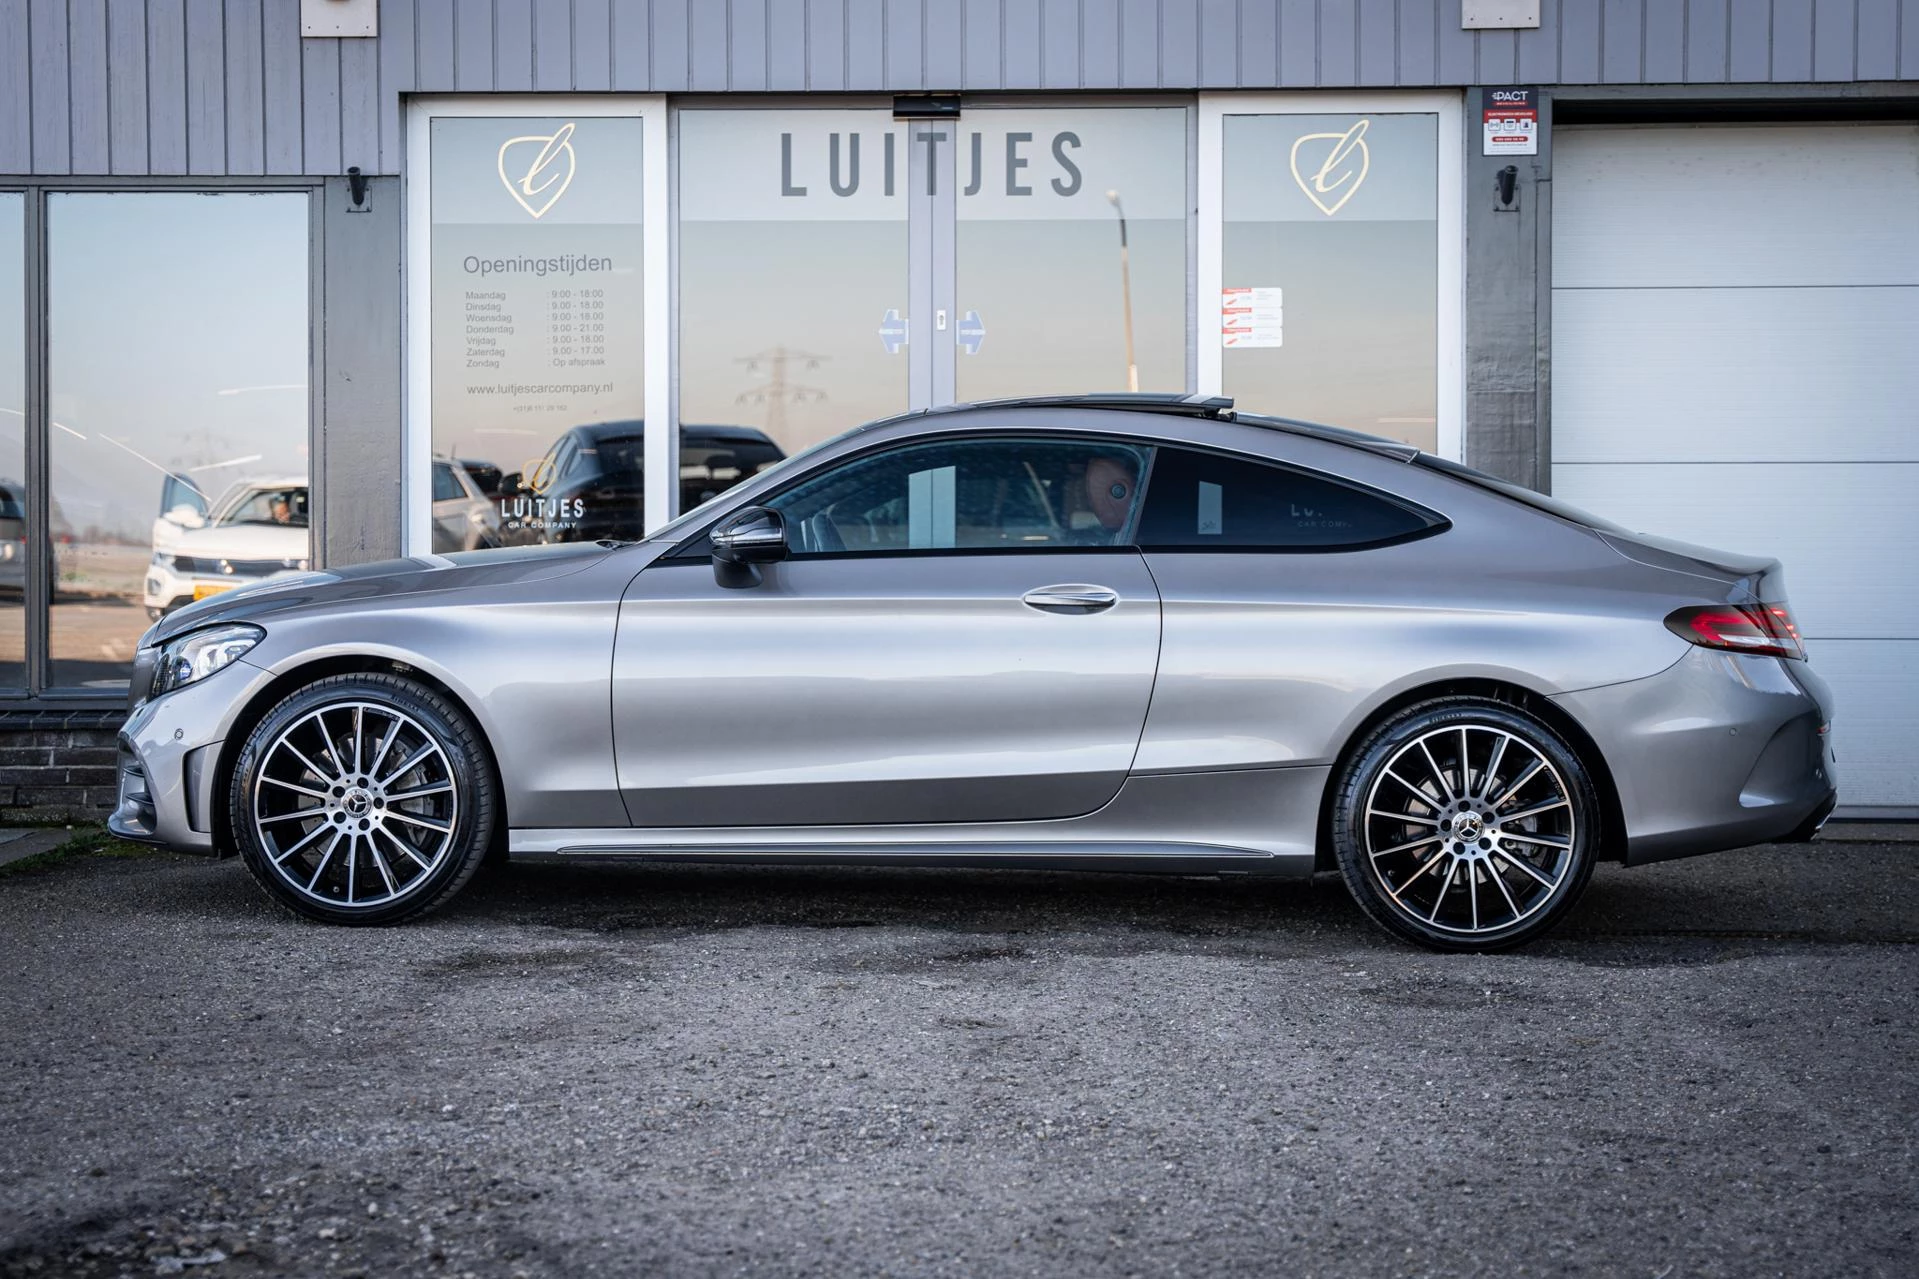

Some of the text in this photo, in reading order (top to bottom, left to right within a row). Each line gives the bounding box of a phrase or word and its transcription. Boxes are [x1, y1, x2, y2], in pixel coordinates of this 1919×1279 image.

[781, 131, 1082, 197] LUITJES
[463, 254, 612, 277] Openingstijden
[465, 291, 506, 301] Maandag
[465, 302, 502, 312] Dinsdag
[465, 313, 512, 324] Woensdag
[465, 325, 514, 335] Donderdag
[465, 336, 496, 346] Vrijdag
[466, 359, 500, 369] Zondag
[553, 358, 566, 368] Op
[466, 382, 614, 396] www.luitjescarcompany.nl
[501, 498, 584, 518] LUITJES
[531, 521, 577, 529] COMPANY
